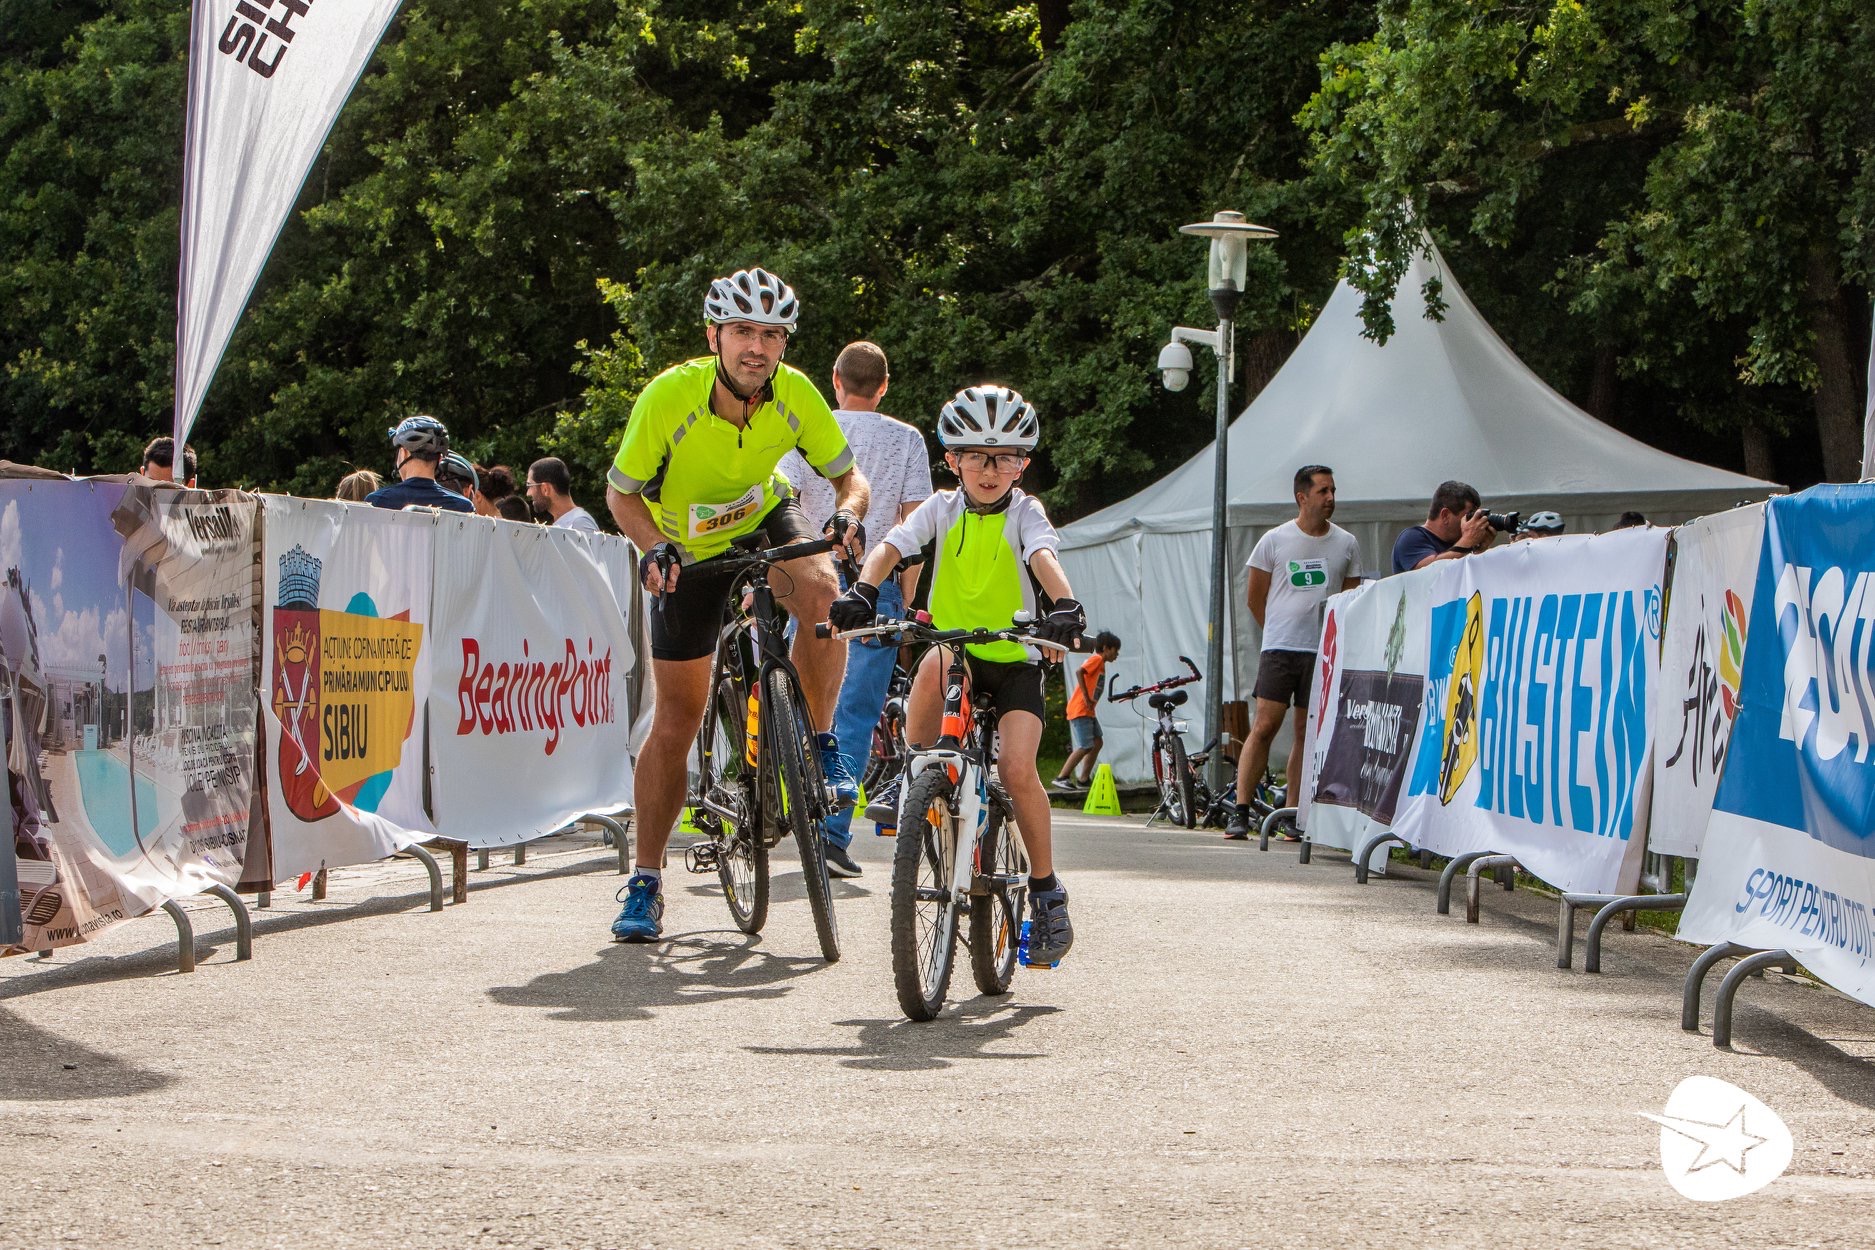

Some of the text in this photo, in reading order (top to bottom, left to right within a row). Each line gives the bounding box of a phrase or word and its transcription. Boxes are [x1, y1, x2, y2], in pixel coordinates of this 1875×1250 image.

[218, 0, 275, 63] SI
[248, 0, 314, 78] CH
[706, 508, 746, 531] 306
[1304, 572, 1313, 585] 9
[401, 639, 413, 660] DE
[457, 637, 611, 756] BearingPoint
[323, 703, 368, 761] SIBIU
[205, 770, 218, 789] PE
[1736, 868, 1803, 929] SPORT
[1790, 882, 1848, 949] PENTRU
